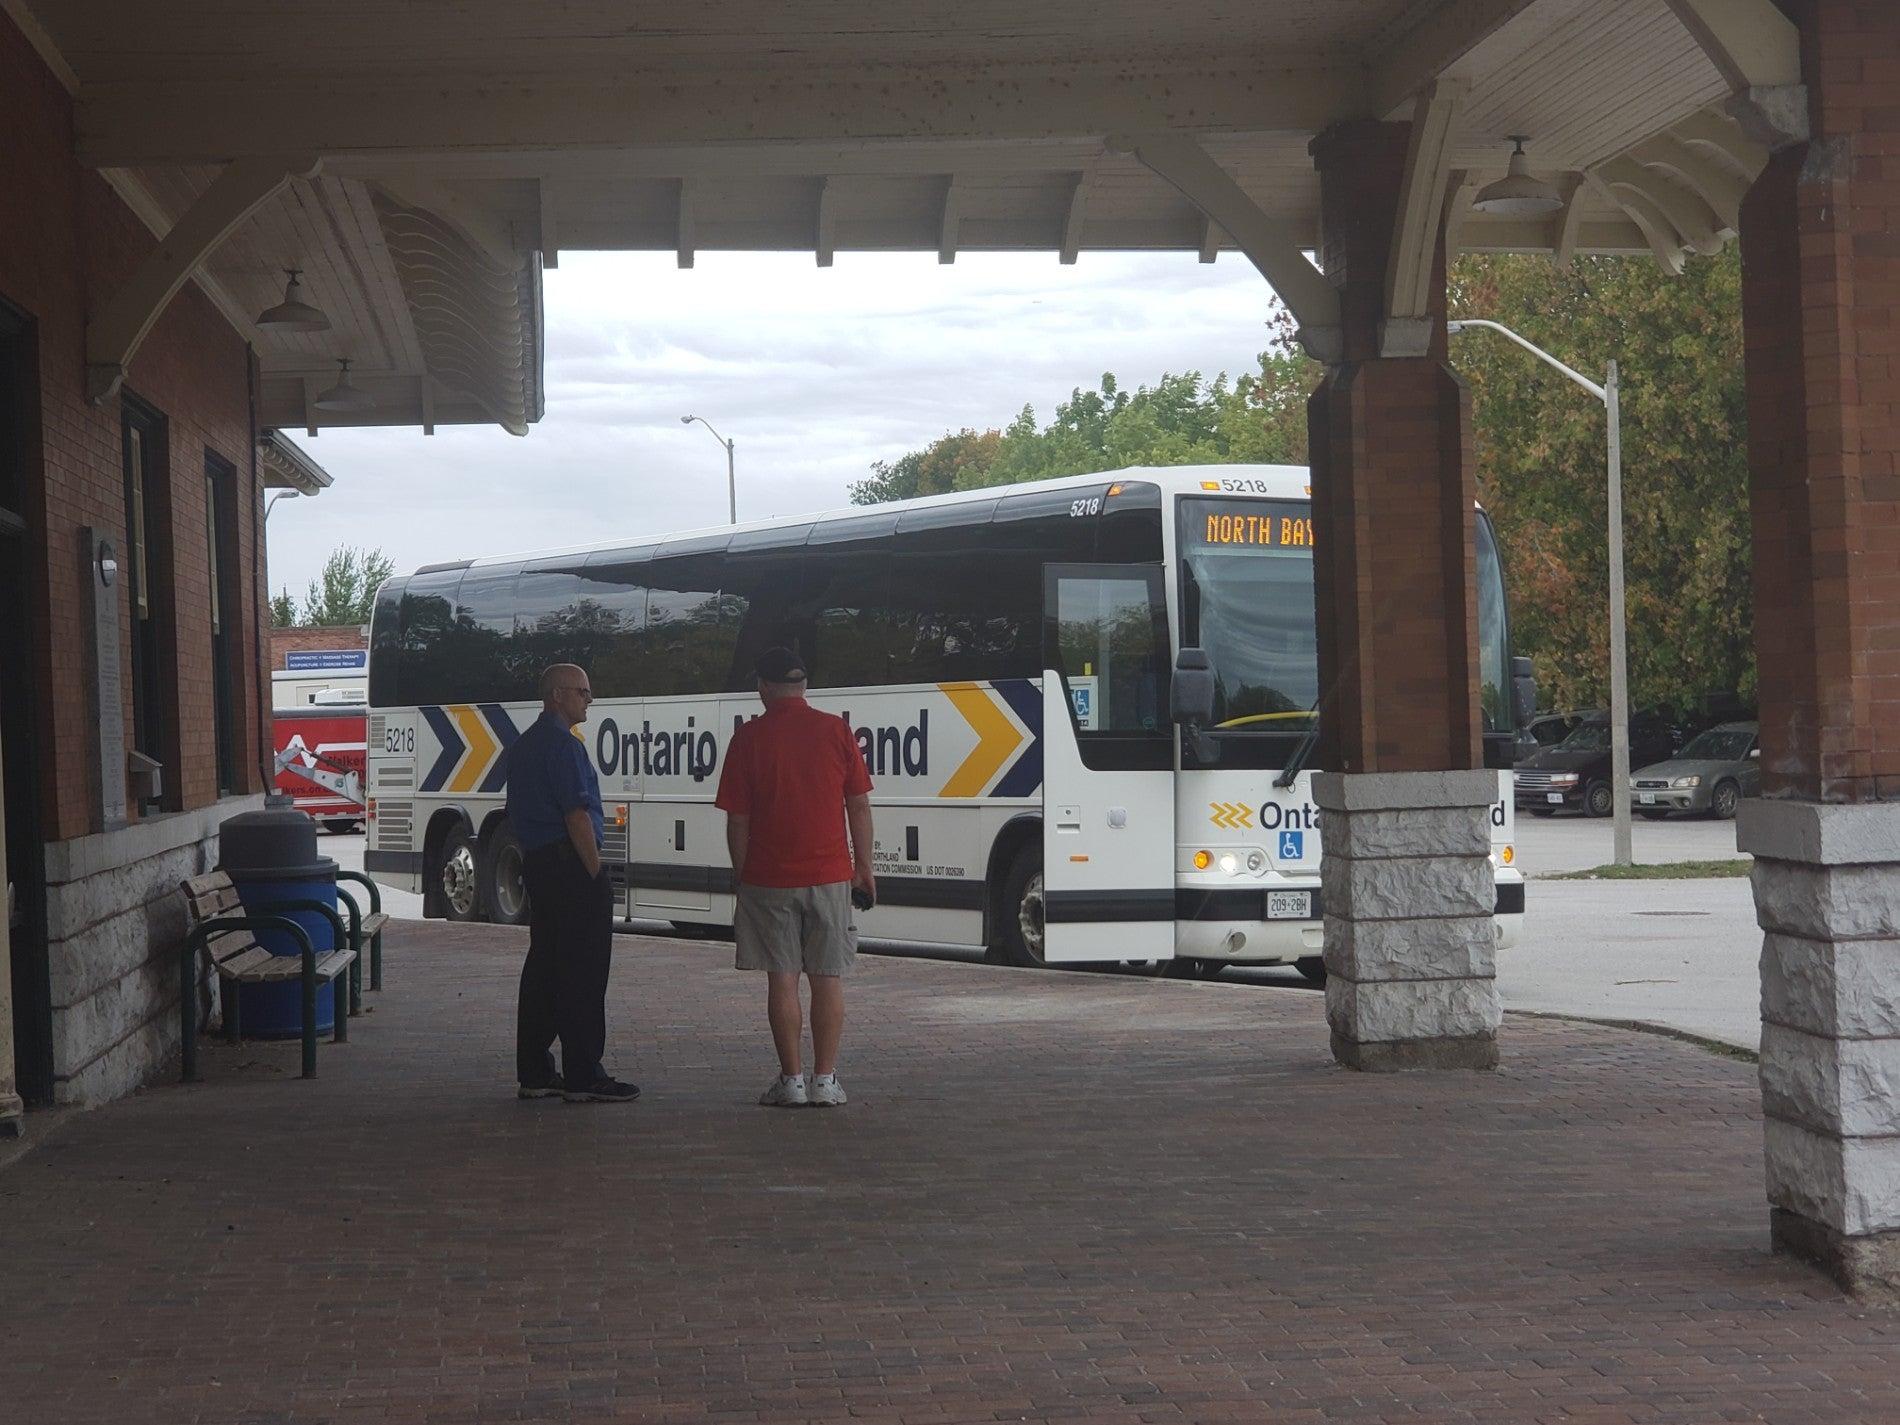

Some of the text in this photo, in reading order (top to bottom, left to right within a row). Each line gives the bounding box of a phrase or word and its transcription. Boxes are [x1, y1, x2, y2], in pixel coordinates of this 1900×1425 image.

[1221, 479, 1268, 494] 5218
[1069, 498, 1099, 517] 5218
[1206, 514, 1271, 545] NORTH
[386, 727, 415, 753] 5218
[597, 716, 717, 777] Ontario
[891, 863, 923, 875] COMMISSION
